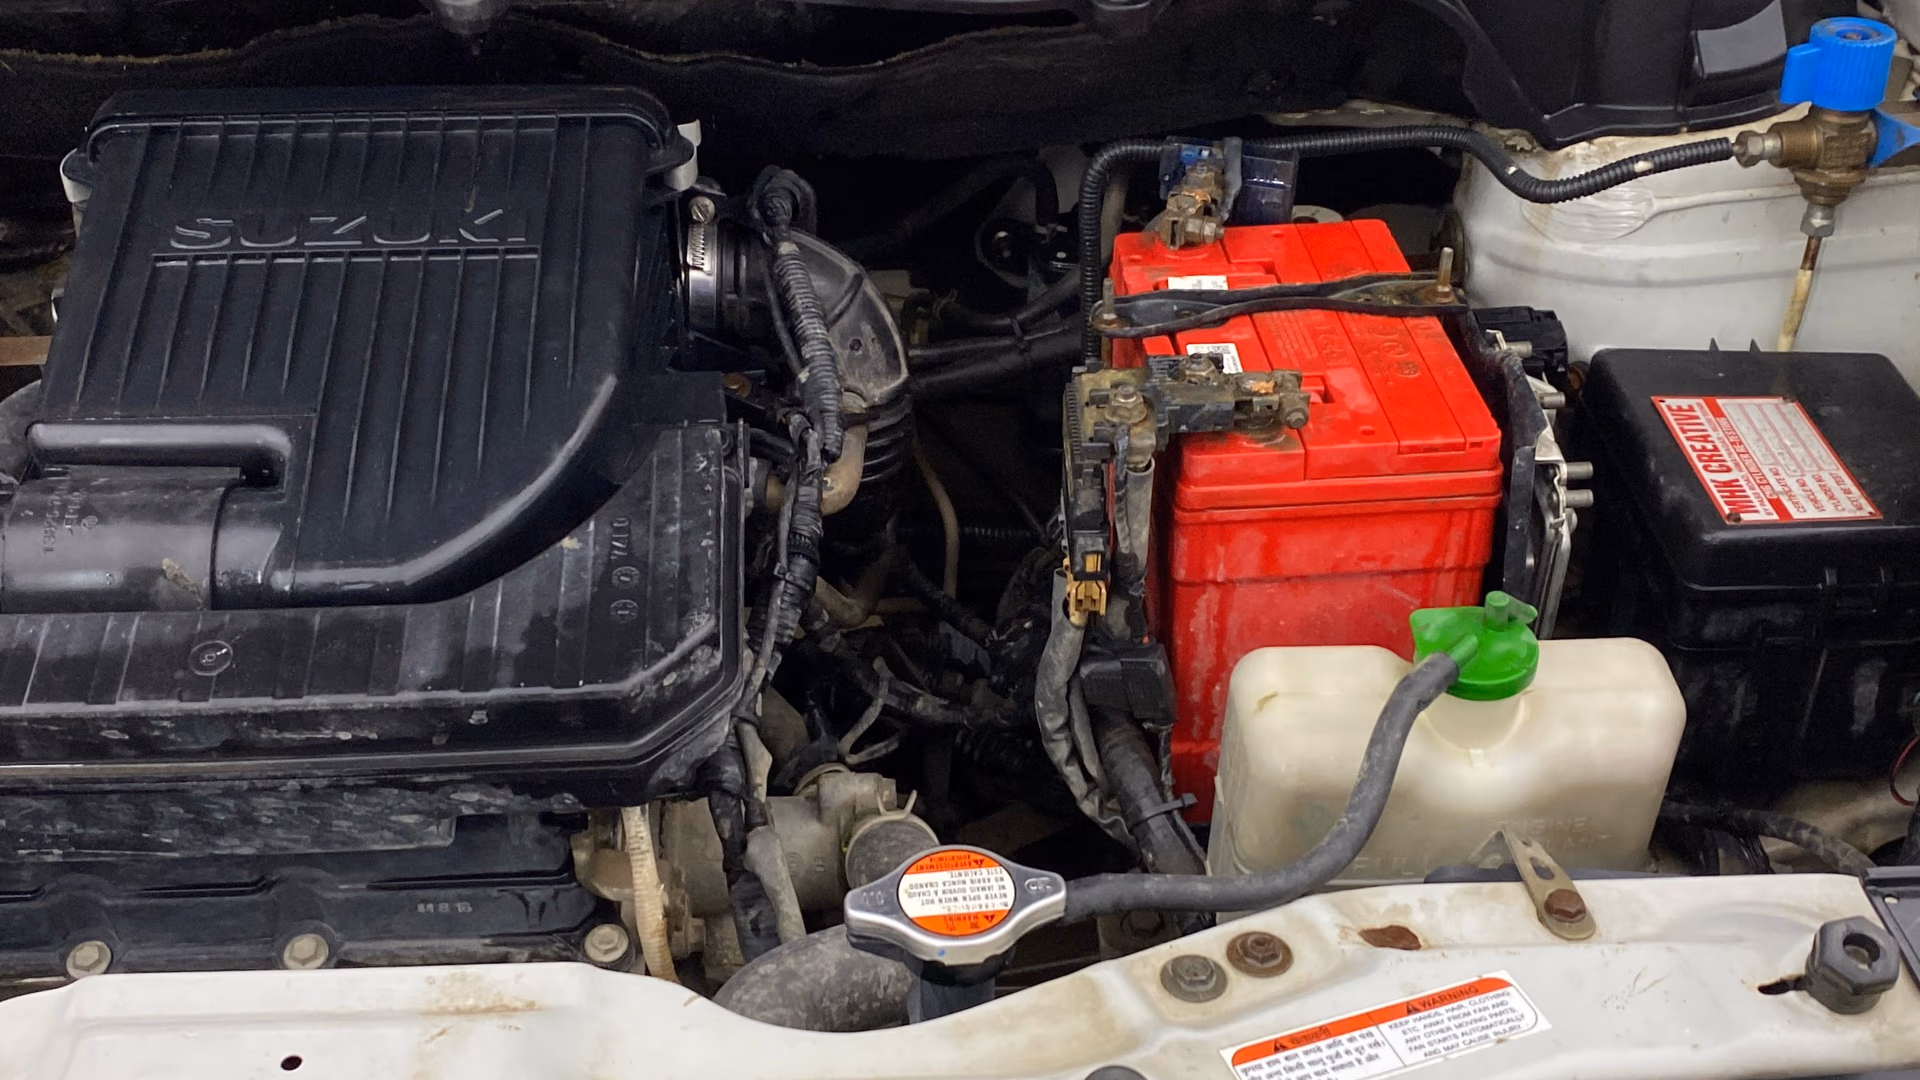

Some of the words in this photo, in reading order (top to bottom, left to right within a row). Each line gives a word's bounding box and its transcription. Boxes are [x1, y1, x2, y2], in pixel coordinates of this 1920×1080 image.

[168, 207, 529, 251] SUZUKI
[1665, 403, 1733, 473] CREATIVE
[1738, 453, 1769, 484] CYLINDER
[1828, 472, 1848, 485] TEST
[1709, 478, 1761, 514] MHK
[1751, 491, 1768, 506] PASS
[1774, 476, 1809, 512] CERTIFICATE
[1801, 488, 1828, 512] VEHICLE
[1816, 482, 1847, 511] CYLINDER
[1845, 495, 1866, 510] NEXT
[942, 879, 966, 887] NUNCA
[942, 887, 966, 895] OUVRIR
[969, 885, 994, 893] JAMAIS
[970, 877, 991, 885] ABRIR
[985, 892, 1007, 900] NEVER
[1419, 985, 1480, 1009] WARNING
[1388, 1019, 1411, 1030] KEEP
[1468, 990, 1511, 1007] CLOTHING
[1422, 1019, 1446, 1029] AWAY
[1446, 1011, 1472, 1022] FROM
[1473, 1006, 1490, 1014] FAN
[1490, 1000, 1509, 1009] AND
[1404, 1035, 1422, 1044] ANY
[1423, 1026, 1453, 1038] OTHER
[1454, 1015, 1488, 1029] MOVING
[1408, 1043, 1426, 1052] FAN
[1426, 1033, 1458, 1047] STARTS
[1459, 1014, 1527, 1038] AUTOMATICALLY
[1422, 1048, 1441, 1057] AND
[1443, 1042, 1462, 1051] MAY
[1462, 1034, 1491, 1046] CAUSE
